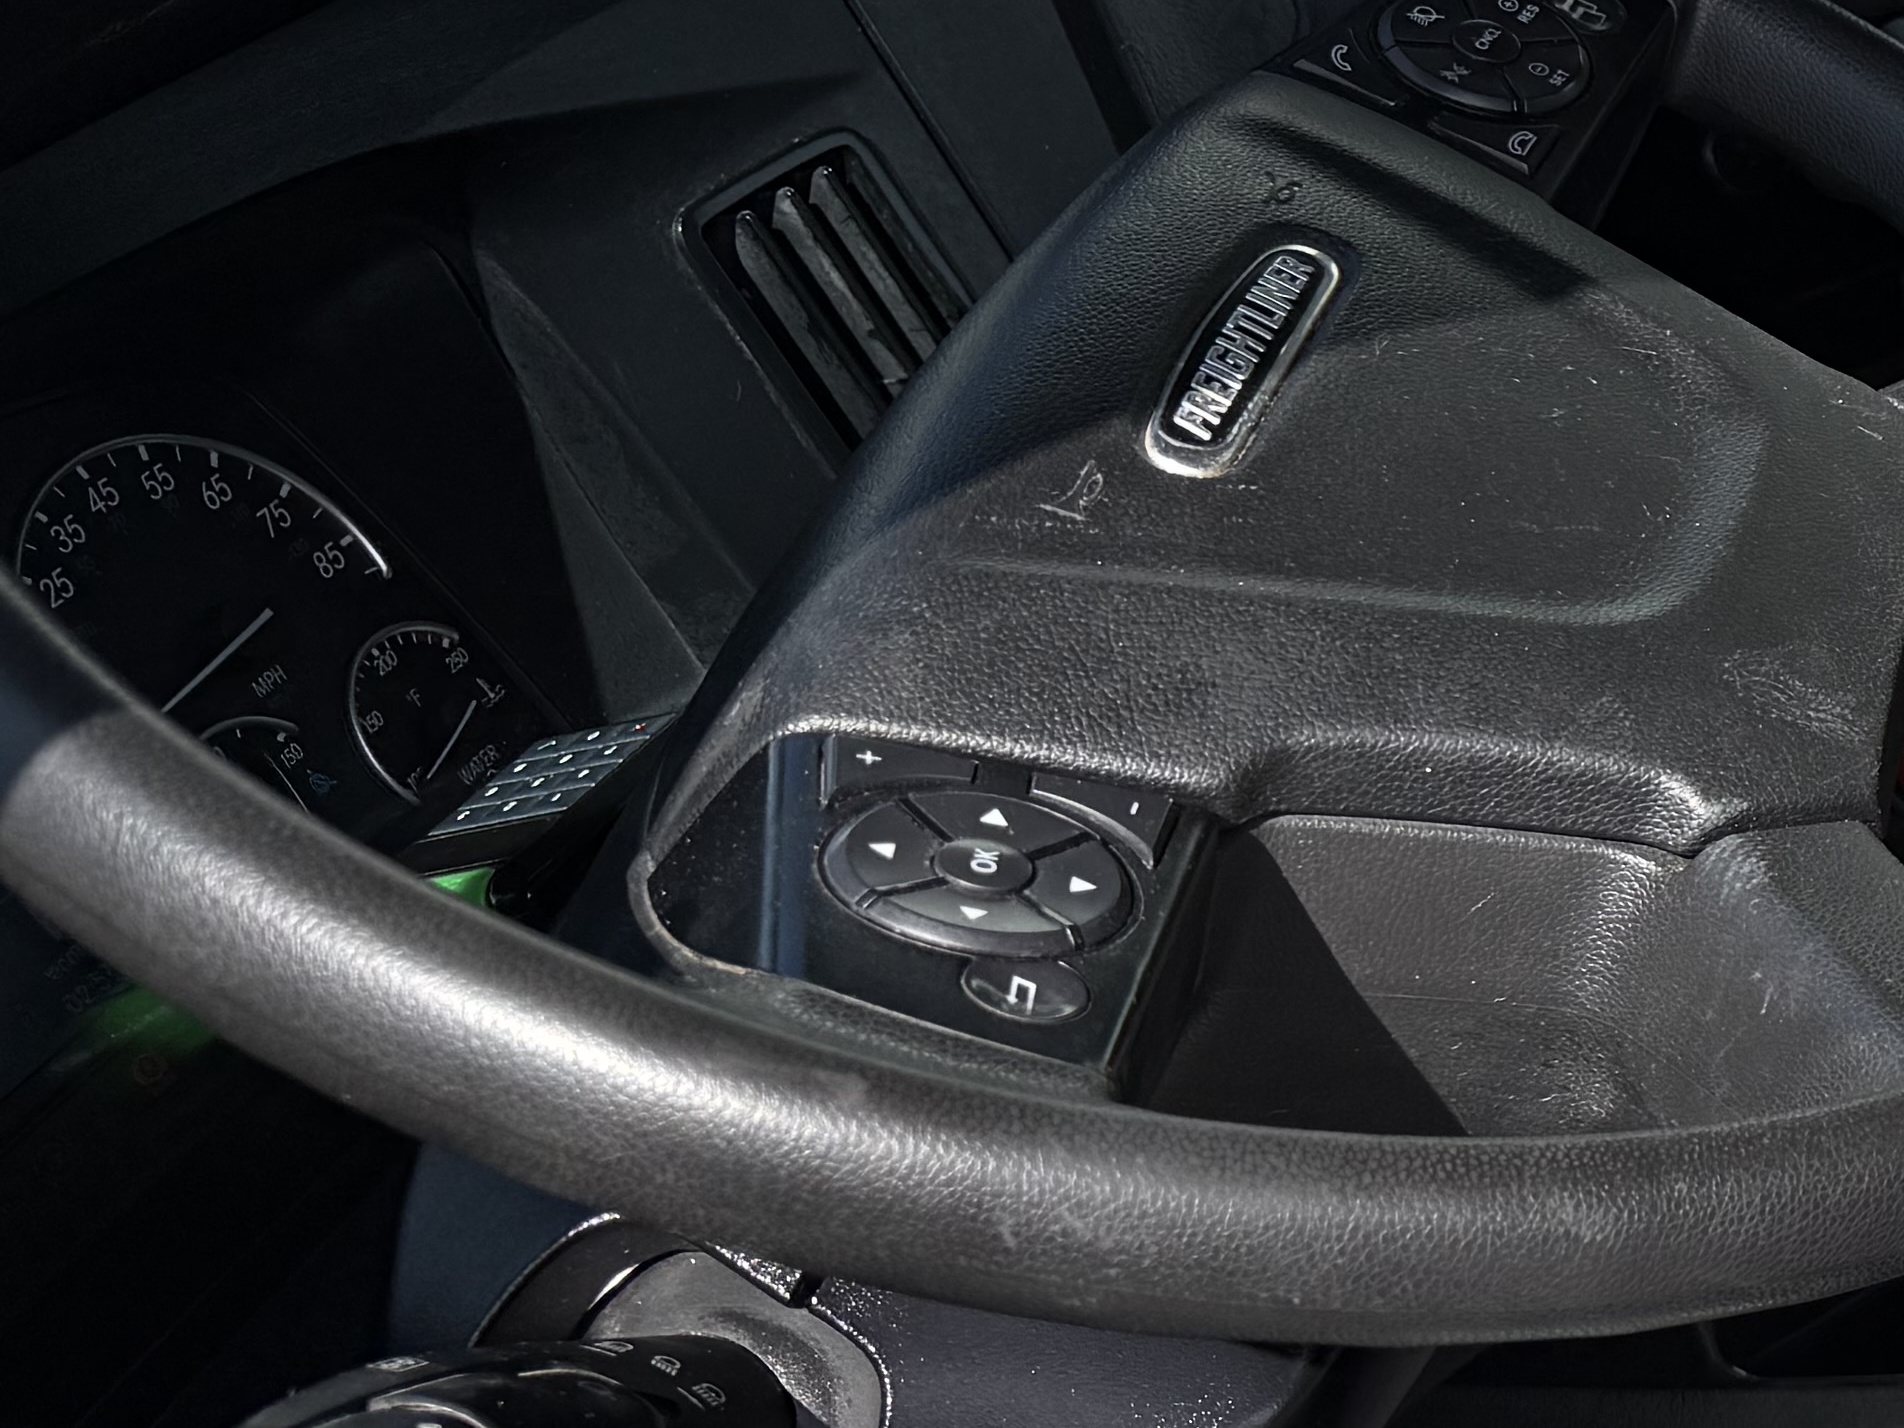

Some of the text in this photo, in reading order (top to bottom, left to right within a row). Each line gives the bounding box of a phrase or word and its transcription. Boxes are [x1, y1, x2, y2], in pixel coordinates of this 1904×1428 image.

[1516, 4, 1540, 24] RES
[1475, 28, 1502, 50] CNCL
[1549, 69, 1570, 86] SET
[1173, 255, 1314, 441] FREIGHTLINER
[87, 476, 120, 515] 45
[140, 462, 176, 501] 55
[201, 473, 233, 511] 65
[50, 514, 86, 554] 35
[256, 498, 293, 539] 75
[312, 540, 346, 579] 85
[39, 566, 75, 610] 25
[374, 650, 398, 677] 200
[445, 647, 469, 674] 250
[251, 664, 289, 699] MPH
[280, 742, 304, 770] 150
[457, 744, 500, 786] WATER
[969, 847, 1002, 873] OK
